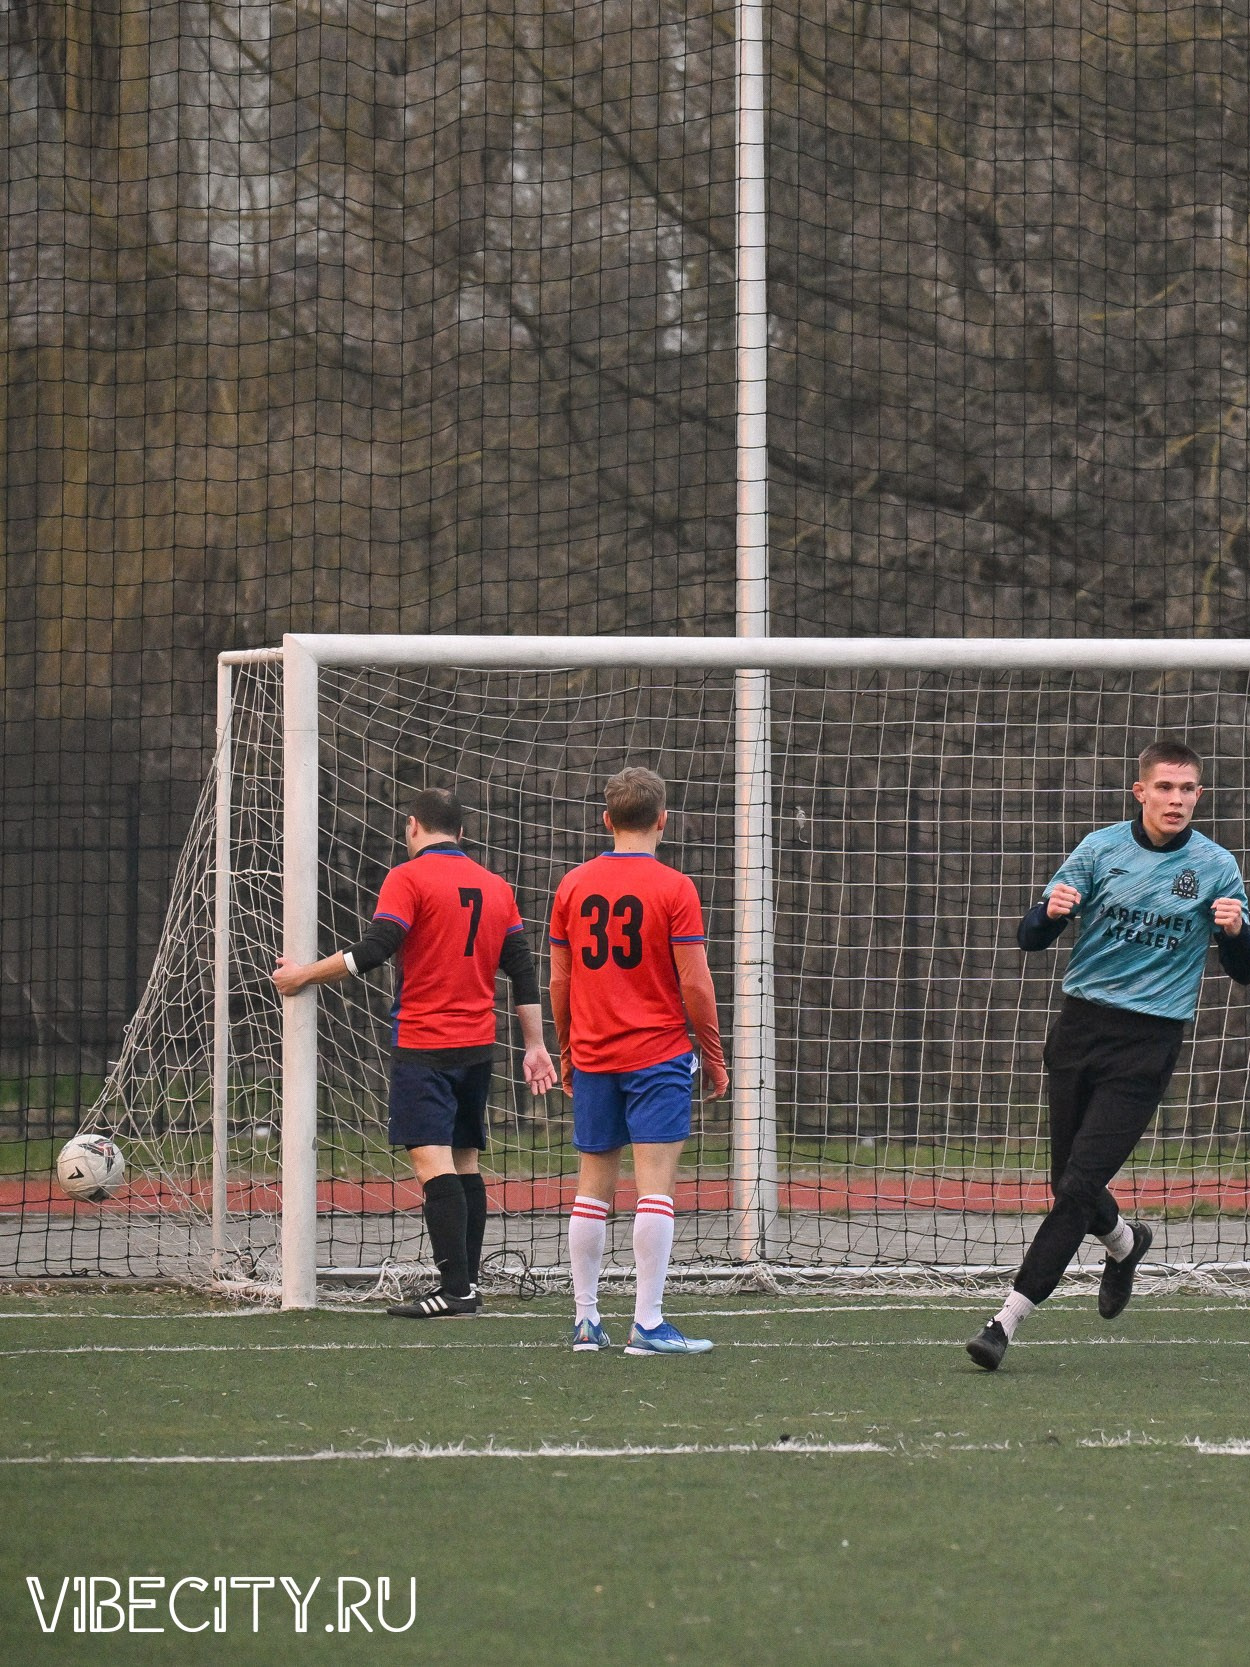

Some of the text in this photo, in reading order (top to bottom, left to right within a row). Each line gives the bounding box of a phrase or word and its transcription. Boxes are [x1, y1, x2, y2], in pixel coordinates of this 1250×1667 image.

[457, 887, 483, 957] 7
[580, 894, 644, 970] 33
[1102, 925, 1180, 950] ATELIER
